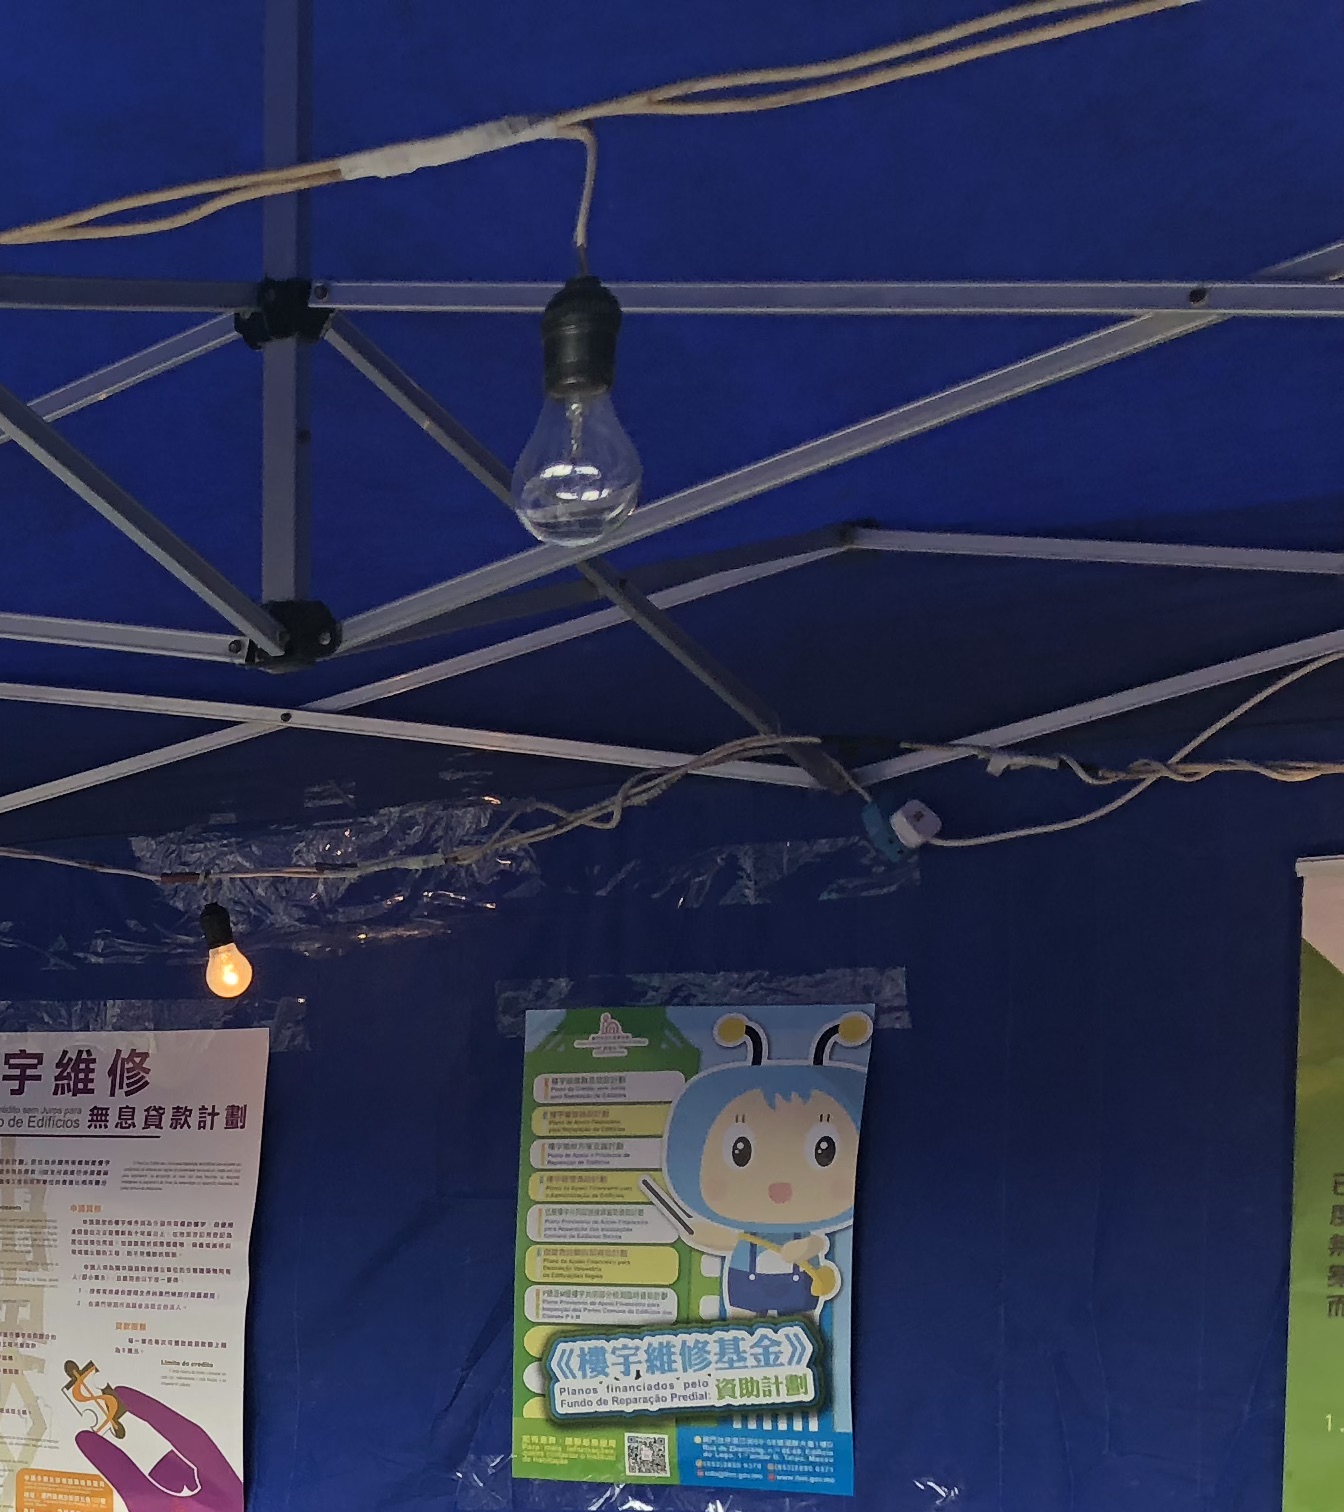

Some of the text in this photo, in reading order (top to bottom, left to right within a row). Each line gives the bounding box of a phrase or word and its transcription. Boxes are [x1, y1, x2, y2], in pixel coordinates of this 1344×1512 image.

[8, 1115, 23, 1128] de
[28, 1115, 80, 1129] Edifícios
[87, 1104, 247, 1131] 無息貸款計劃
[557, 1332, 807, 1381] 《樓宇維修基金》
[559, 1379, 709, 1396] Planos financiados pelo
[715, 1373, 808, 1400] 資助計劃
[560, 1391, 711, 1408] Fundo de Reparação Predial:
